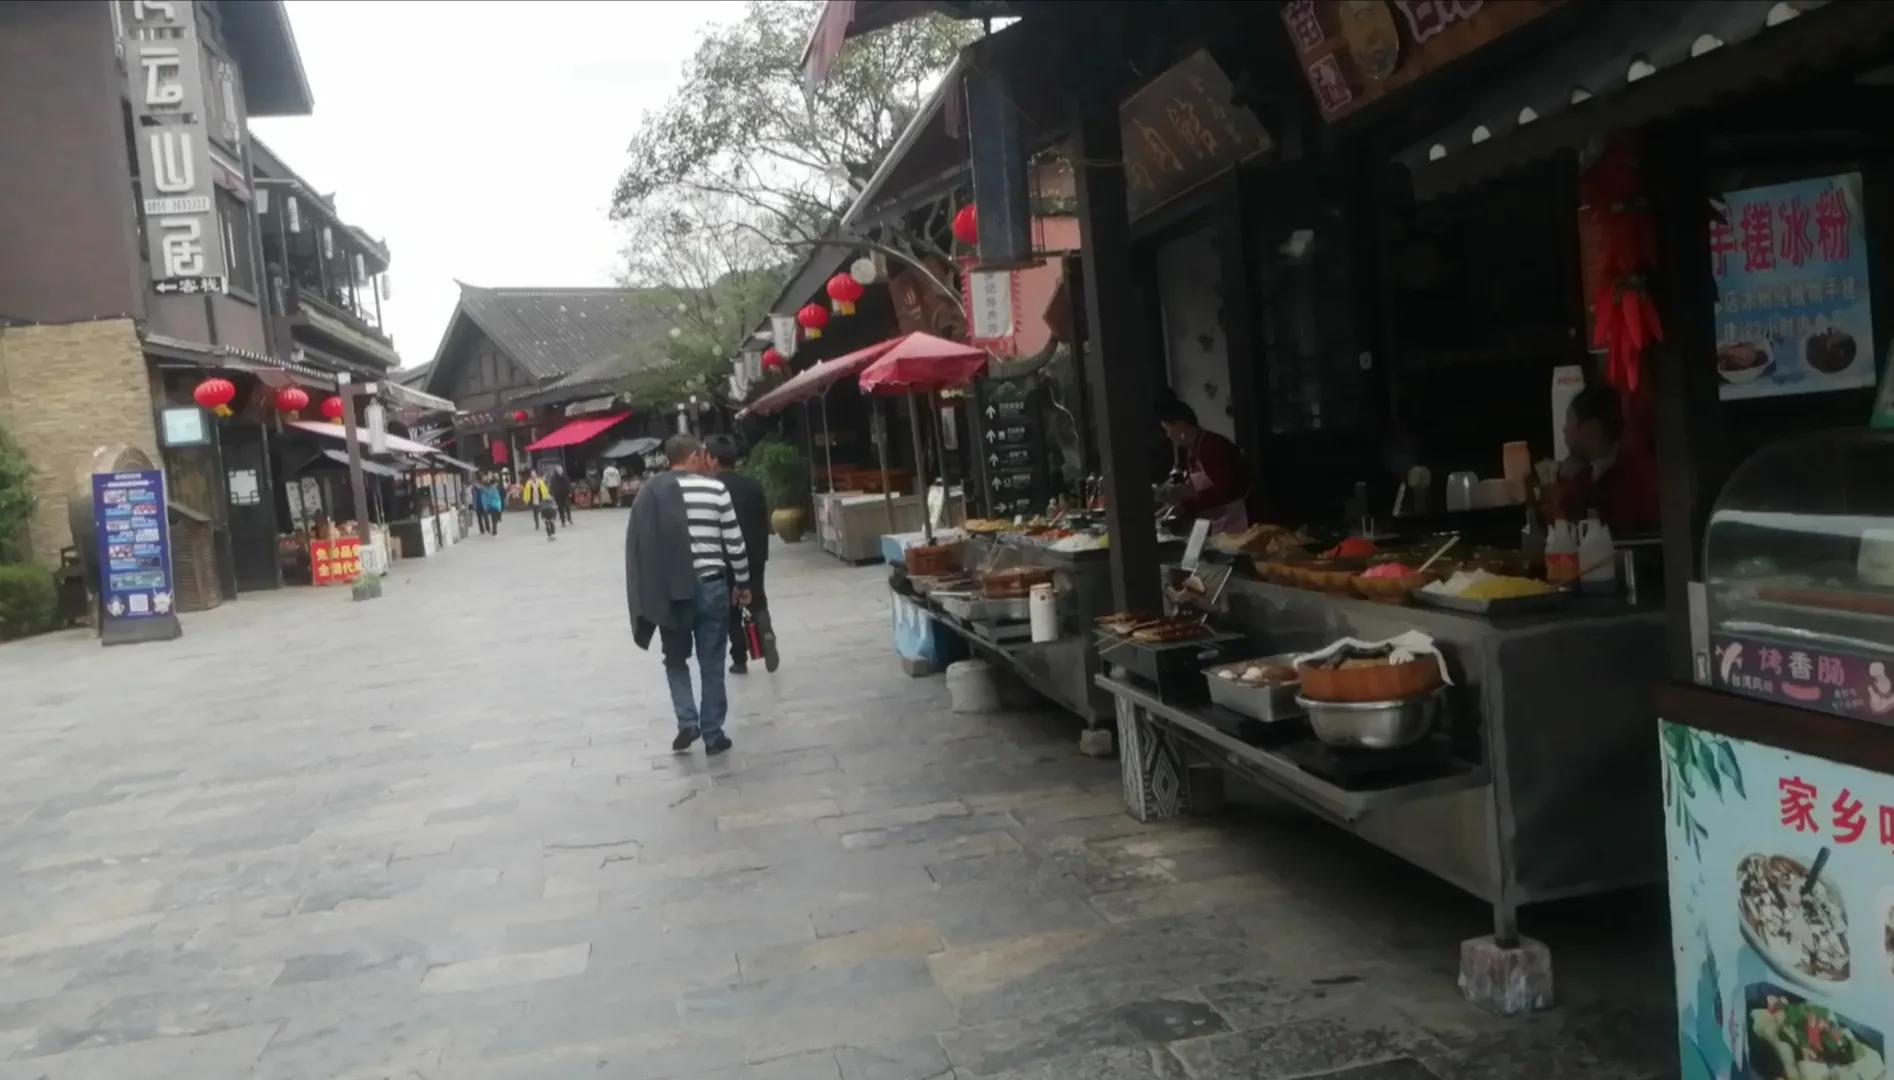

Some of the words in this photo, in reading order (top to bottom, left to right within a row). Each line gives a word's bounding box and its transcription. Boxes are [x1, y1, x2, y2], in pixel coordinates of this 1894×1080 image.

[179, 278, 220, 293] 客栈
[1758, 646, 1845, 686] 烤香肠
